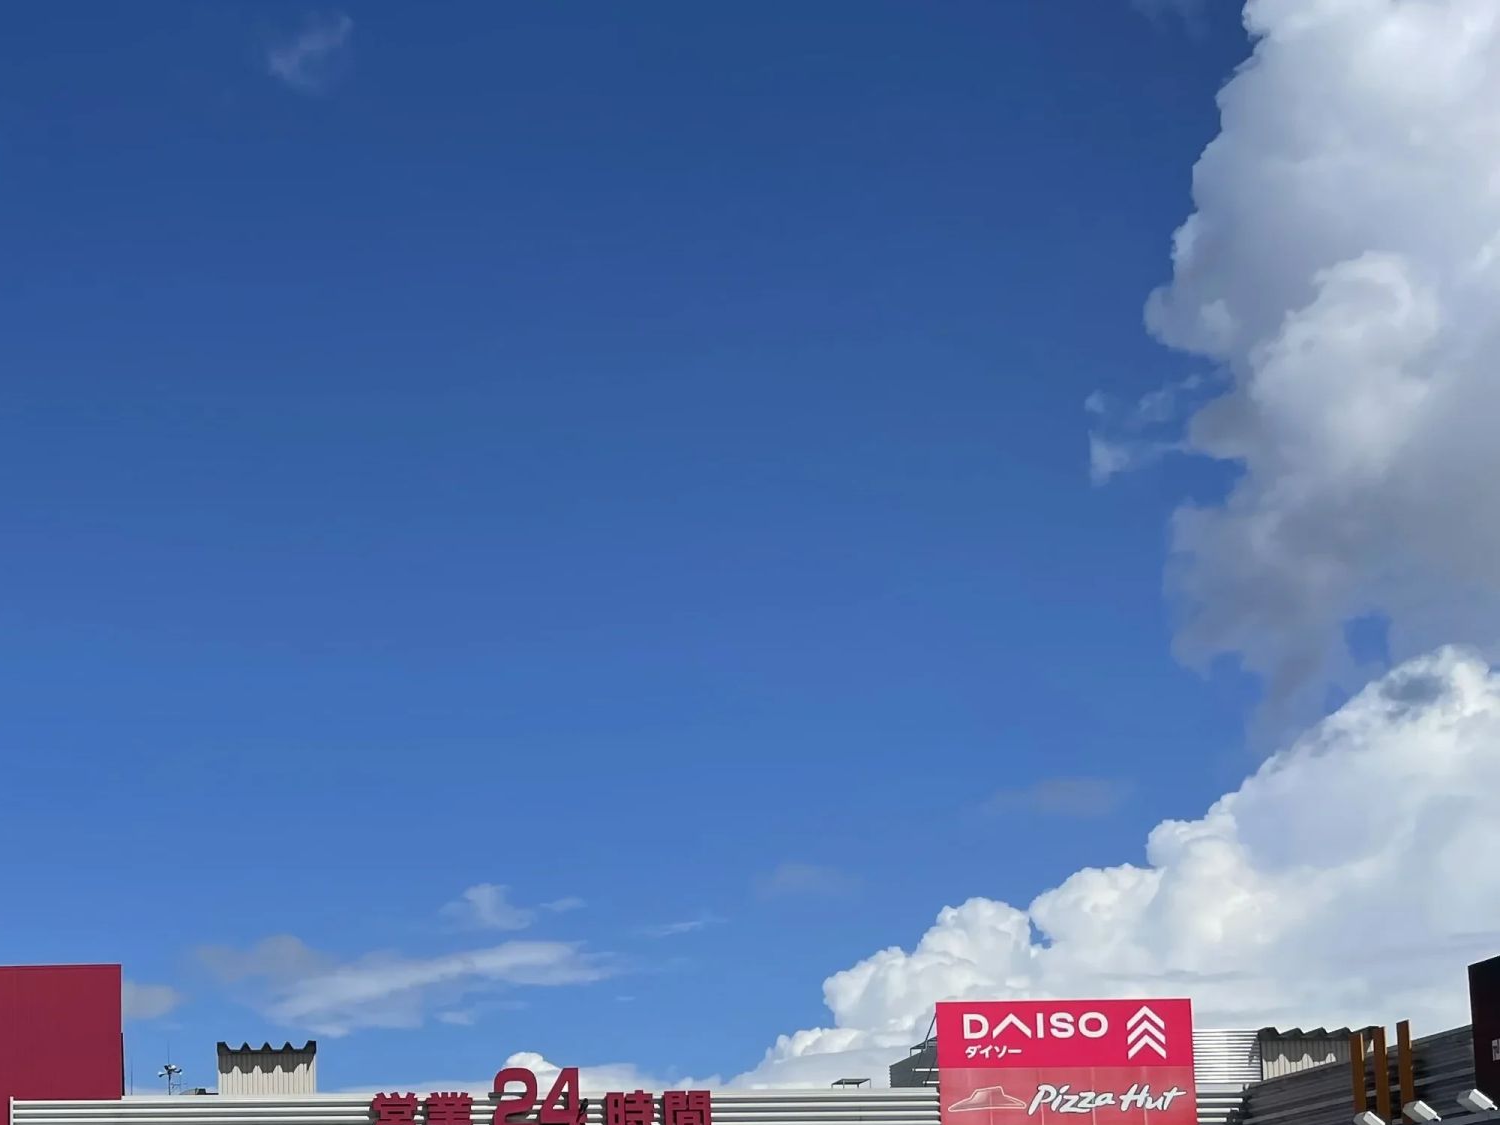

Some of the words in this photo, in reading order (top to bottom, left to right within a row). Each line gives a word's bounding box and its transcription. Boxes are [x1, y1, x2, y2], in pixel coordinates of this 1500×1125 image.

[963, 1012, 1109, 1040] DAISO
[965, 1044, 1022, 1059] ダイソー
[1027, 1083, 1116, 1117] Pizza
[1119, 1083, 1188, 1112] Hut
